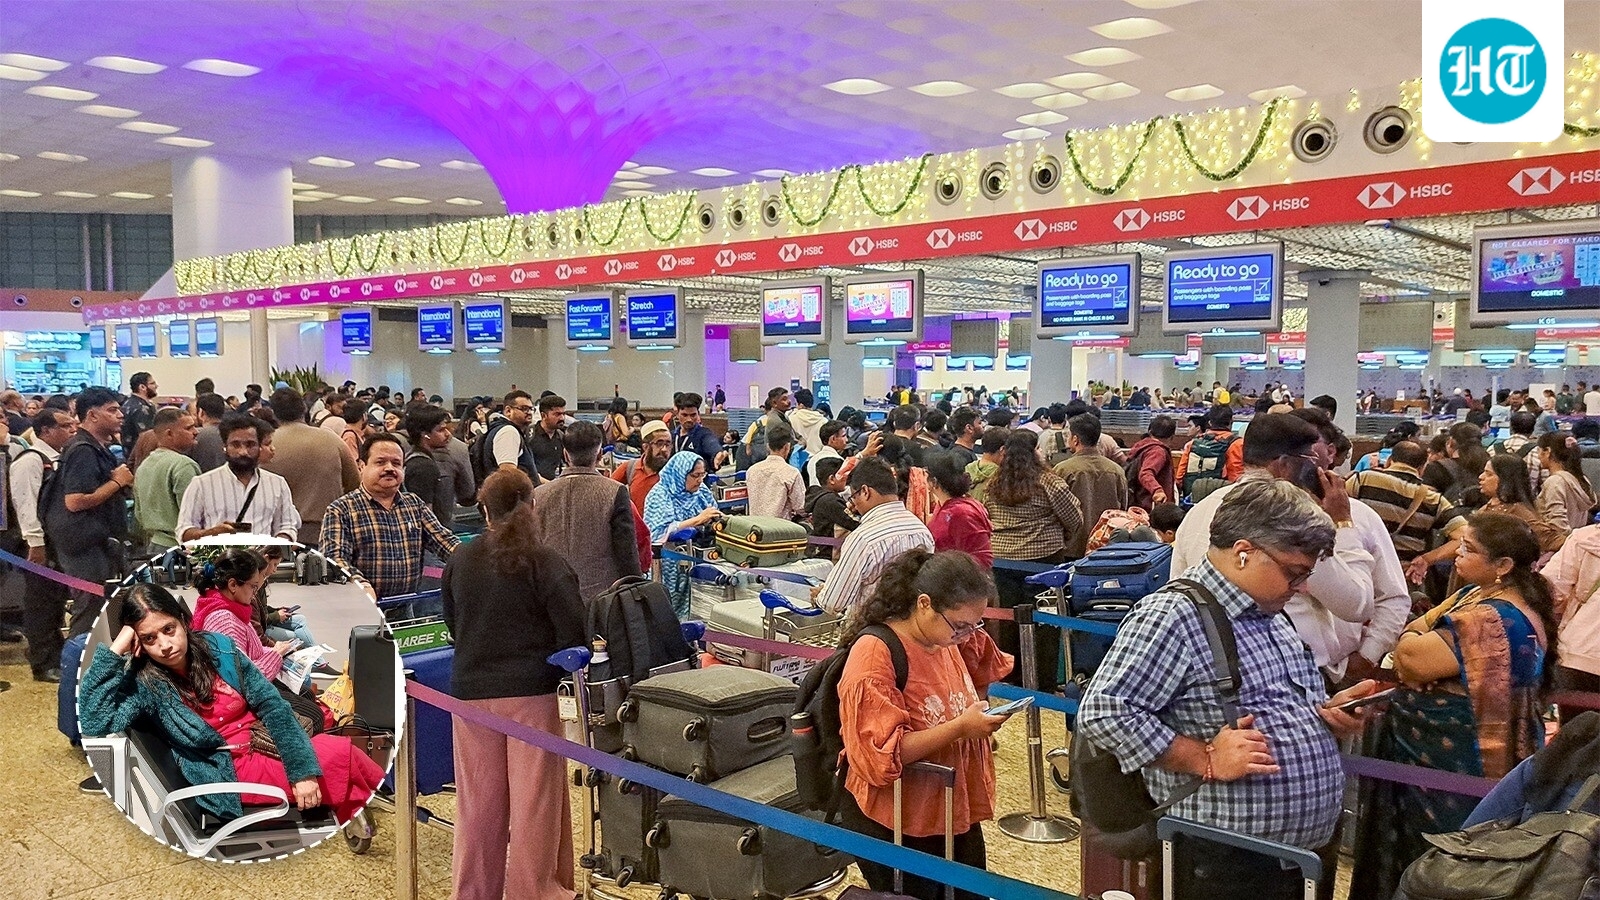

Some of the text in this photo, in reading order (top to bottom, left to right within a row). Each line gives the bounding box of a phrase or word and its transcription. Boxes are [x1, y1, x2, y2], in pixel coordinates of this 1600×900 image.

[1410, 183, 1453, 198] HSBC
[1272, 196, 1310, 212] HSBC
[1153, 210, 1186, 224] HSBC
[1049, 220, 1078, 233] HSBC
[957, 230, 983, 242] HSBC
[876, 239, 899, 249] HSBC
[1512, 240, 1549, 248] CLEARED
[803, 246, 824, 256] HSBC
[678, 256, 695, 266] HSBC
[738, 252, 757, 261] HSBC
[572, 266, 588, 274] HSBC
[623, 261, 640, 270] HSBC
[526, 270, 541, 278] HSBC
[1174, 263, 1260, 281] Ready to go
[1046, 272, 1118, 289] Ready to go
[569, 304, 602, 313] Fast Forward
[630, 301, 654, 310] Stretch
[421, 311, 451, 321] International
[467, 308, 501, 318] International
